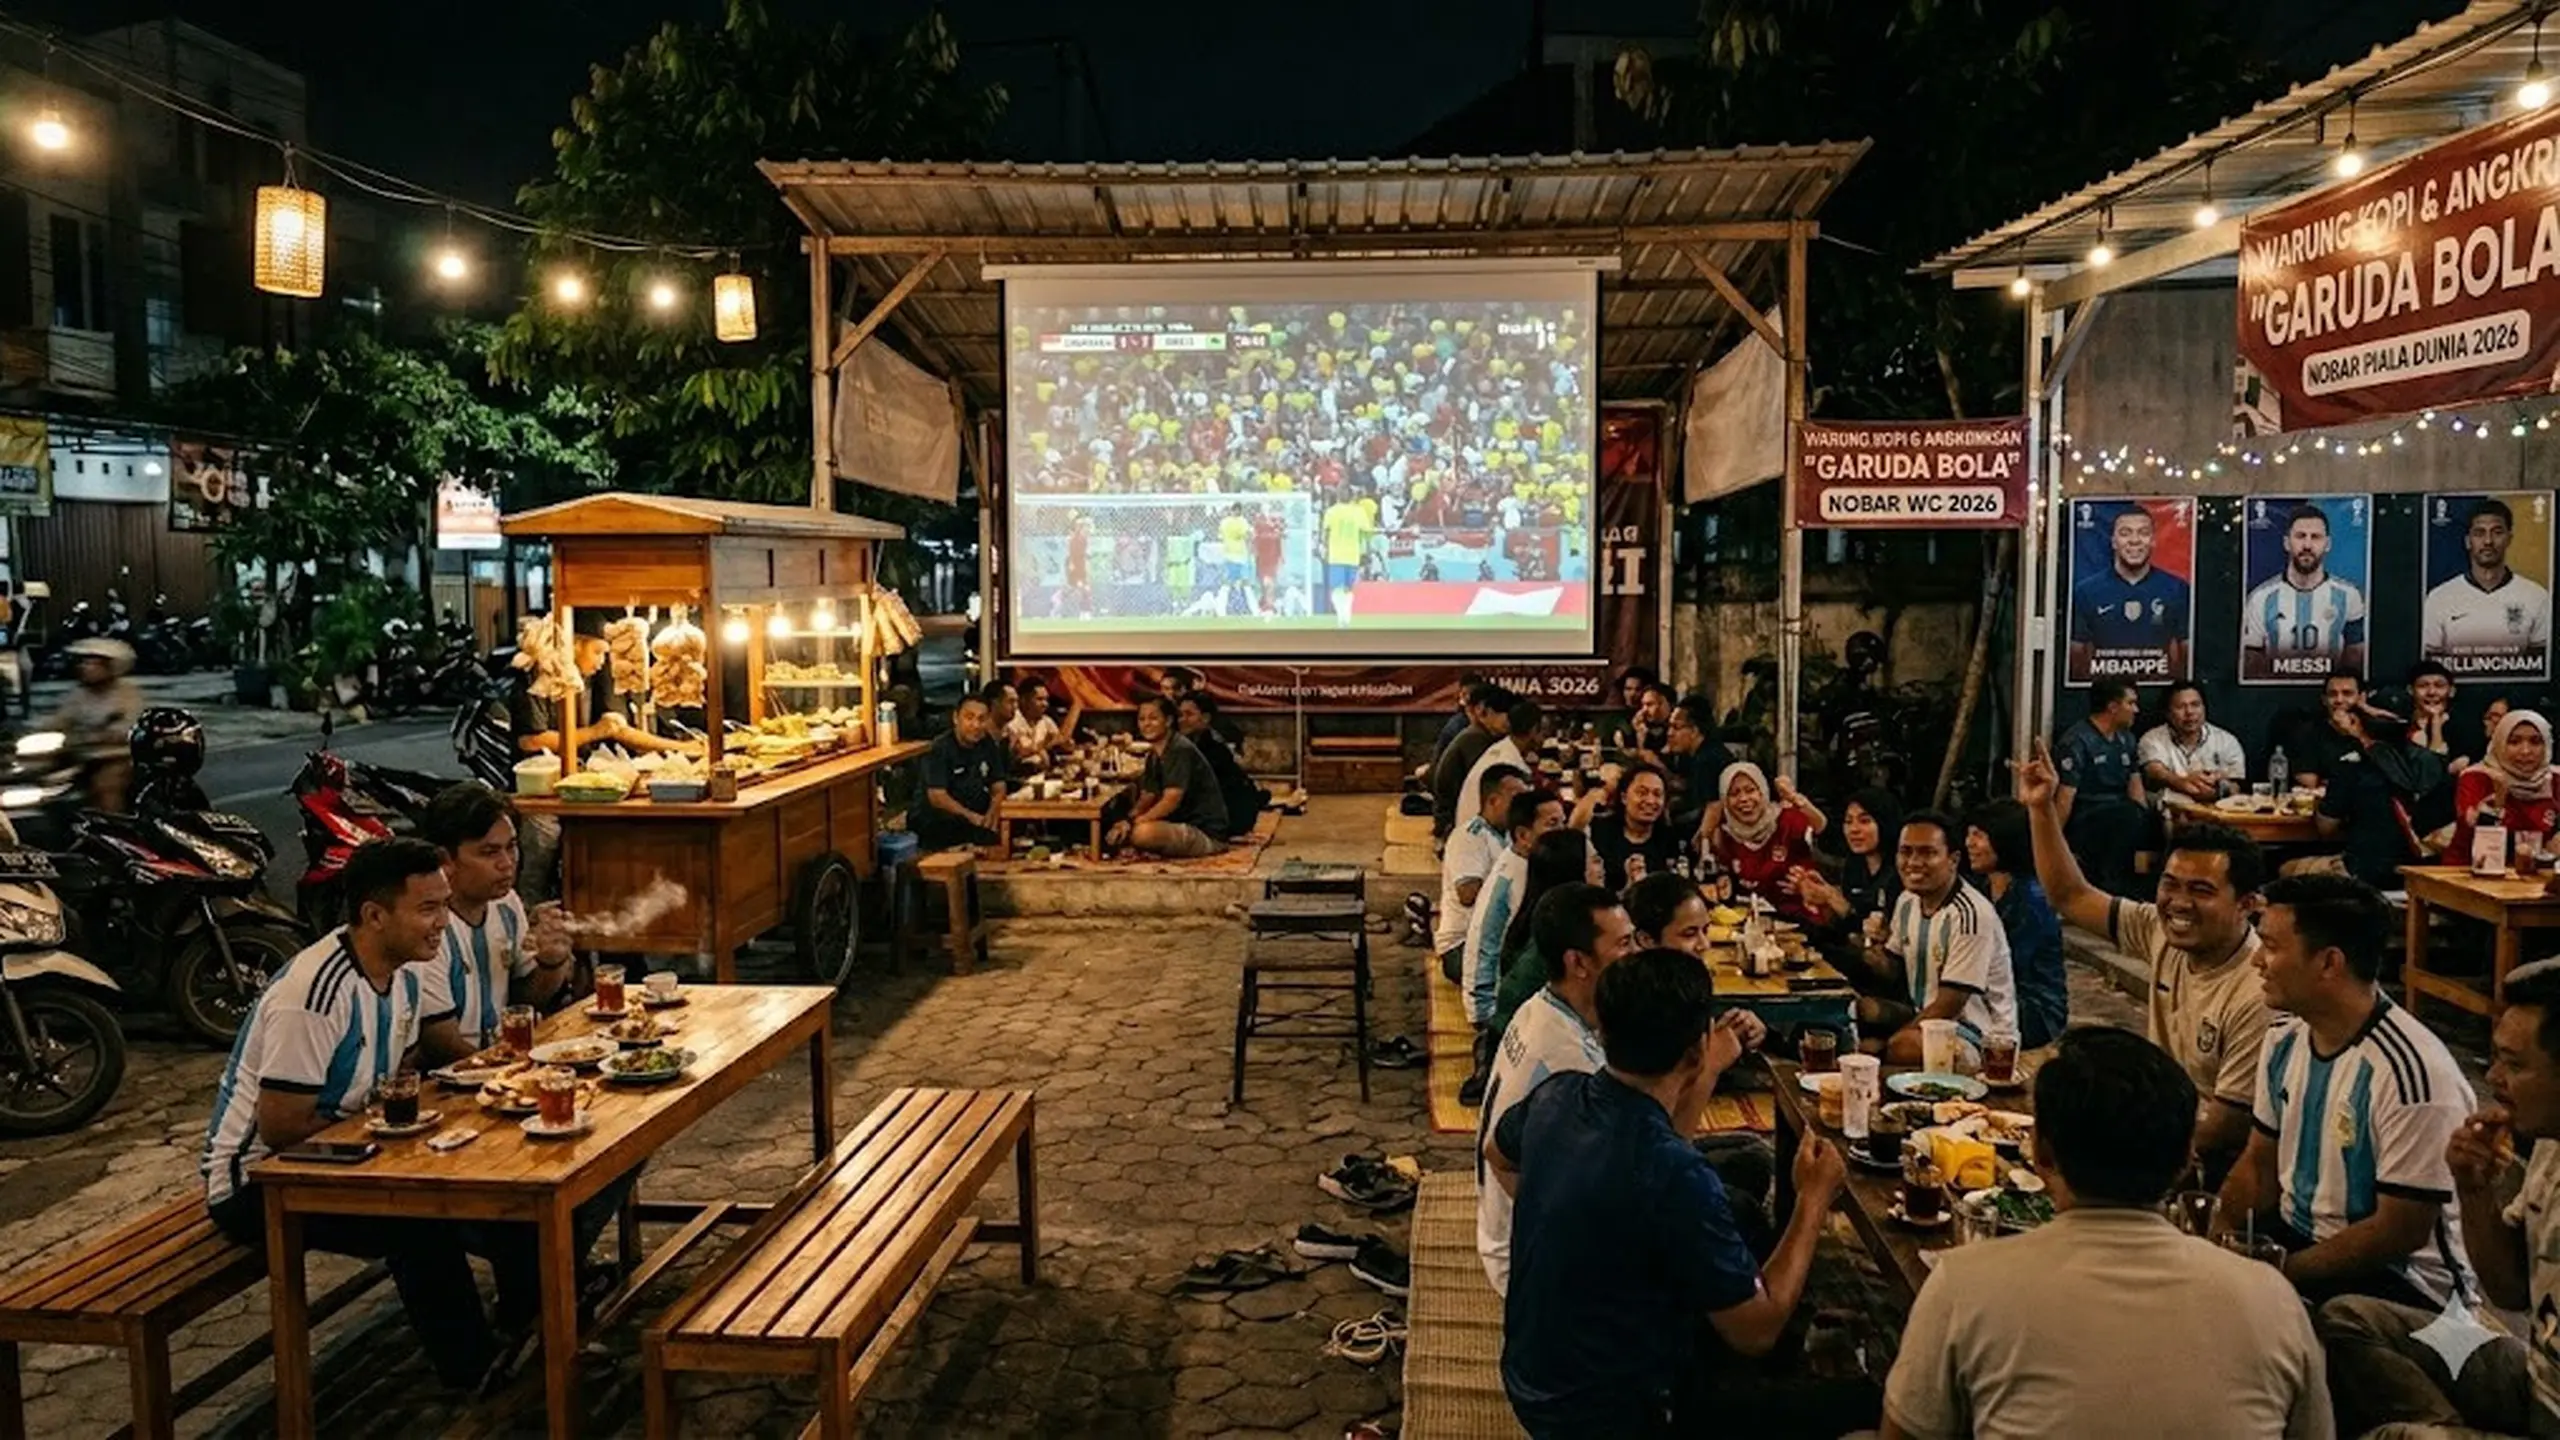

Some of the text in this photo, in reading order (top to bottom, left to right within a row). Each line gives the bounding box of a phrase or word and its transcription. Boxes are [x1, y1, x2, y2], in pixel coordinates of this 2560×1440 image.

[2257, 211, 2352, 270] WARUNG
[2358, 186, 2415, 242] KOPI
[2251, 251, 2421, 346] "GARUDA
[2307, 320, 2520, 387] NOBAR PIALA DUNIA 2026
[1804, 431, 1870, 448] WARUNG
[1804, 451, 2021, 480] "GARUDA BOLA"
[1829, 494, 1997, 512] NOBAR WC 2026
[2291, 623, 2319, 651] 10
[2273, 657, 2332, 674] MESSI
